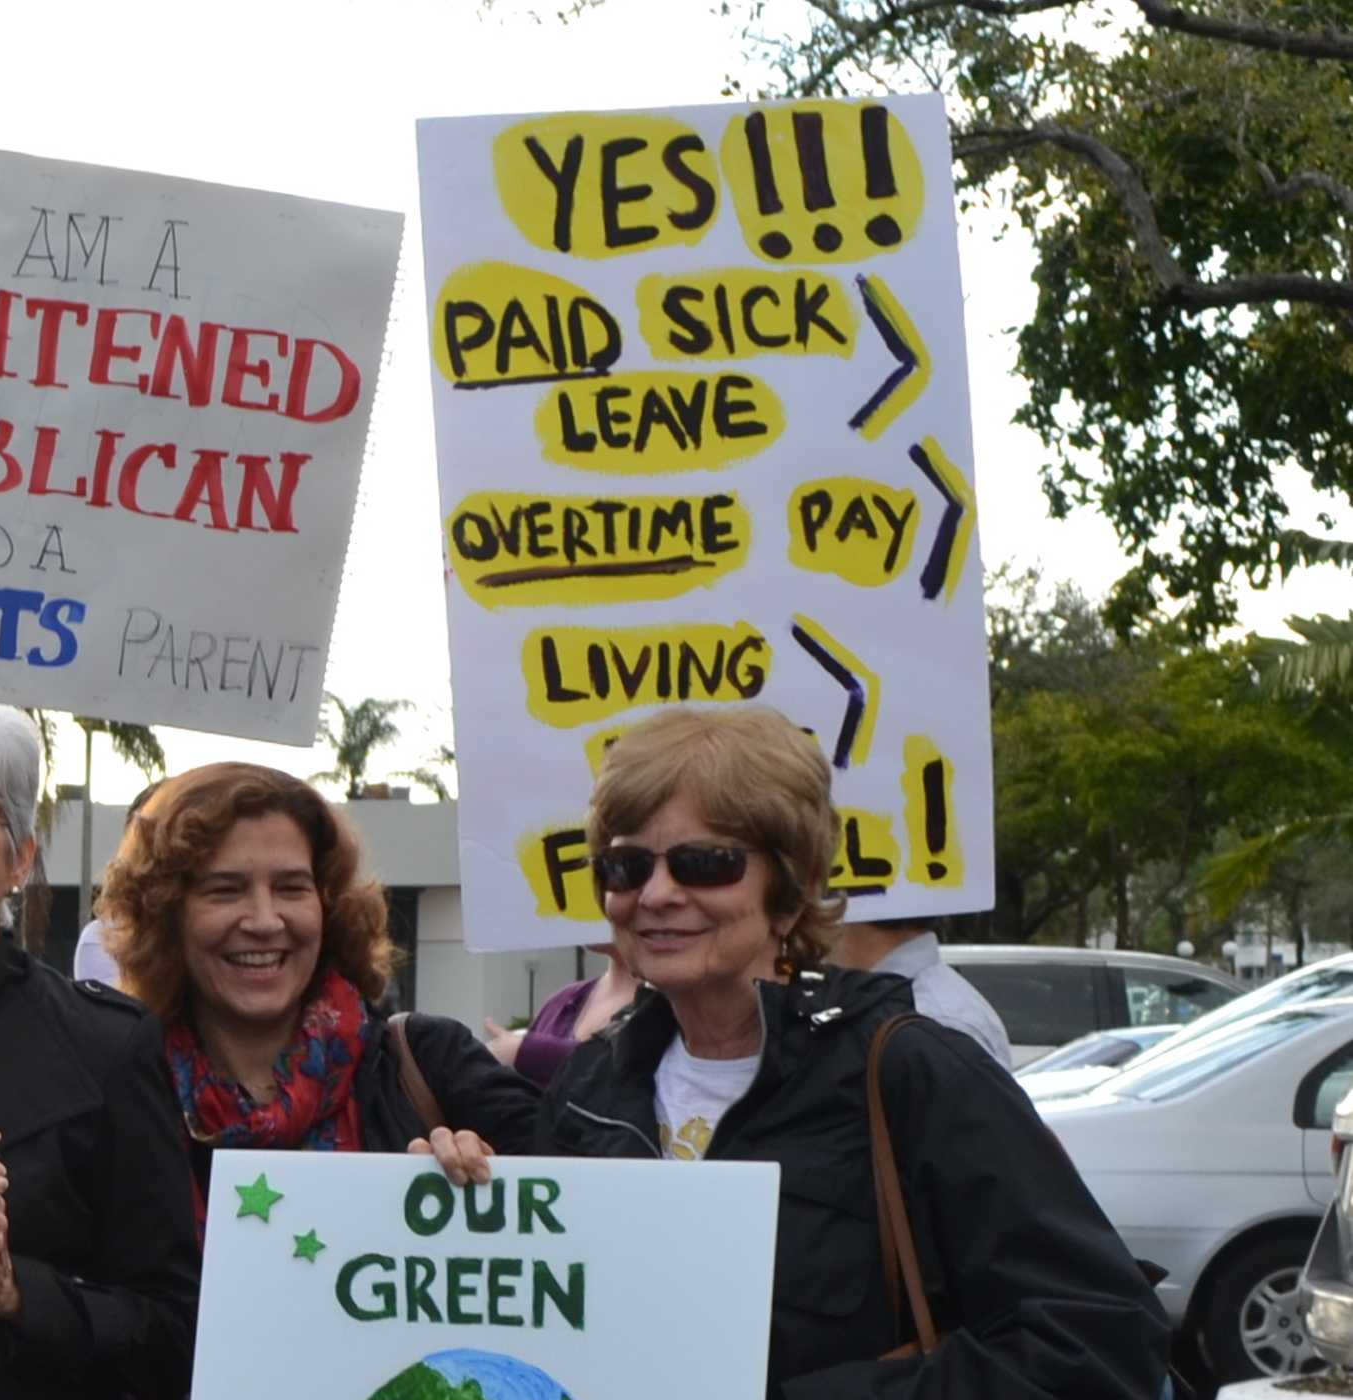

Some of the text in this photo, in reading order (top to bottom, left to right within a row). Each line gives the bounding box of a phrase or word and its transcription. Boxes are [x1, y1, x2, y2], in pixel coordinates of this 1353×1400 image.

[11, 204, 125, 285] AM
[146, 218, 192, 300] A
[444, 278, 850, 377] PAID SICK
[556, 374, 769, 456] LEAVE
[35, 523, 78, 575] A
[452, 488, 917, 576] OVERTIME PAY
[117, 604, 320, 703] PARENT
[540, 634, 767, 702] LIVING
[404, 1172, 566, 1237] OUR
[334, 1253, 587, 1332] GREEN
